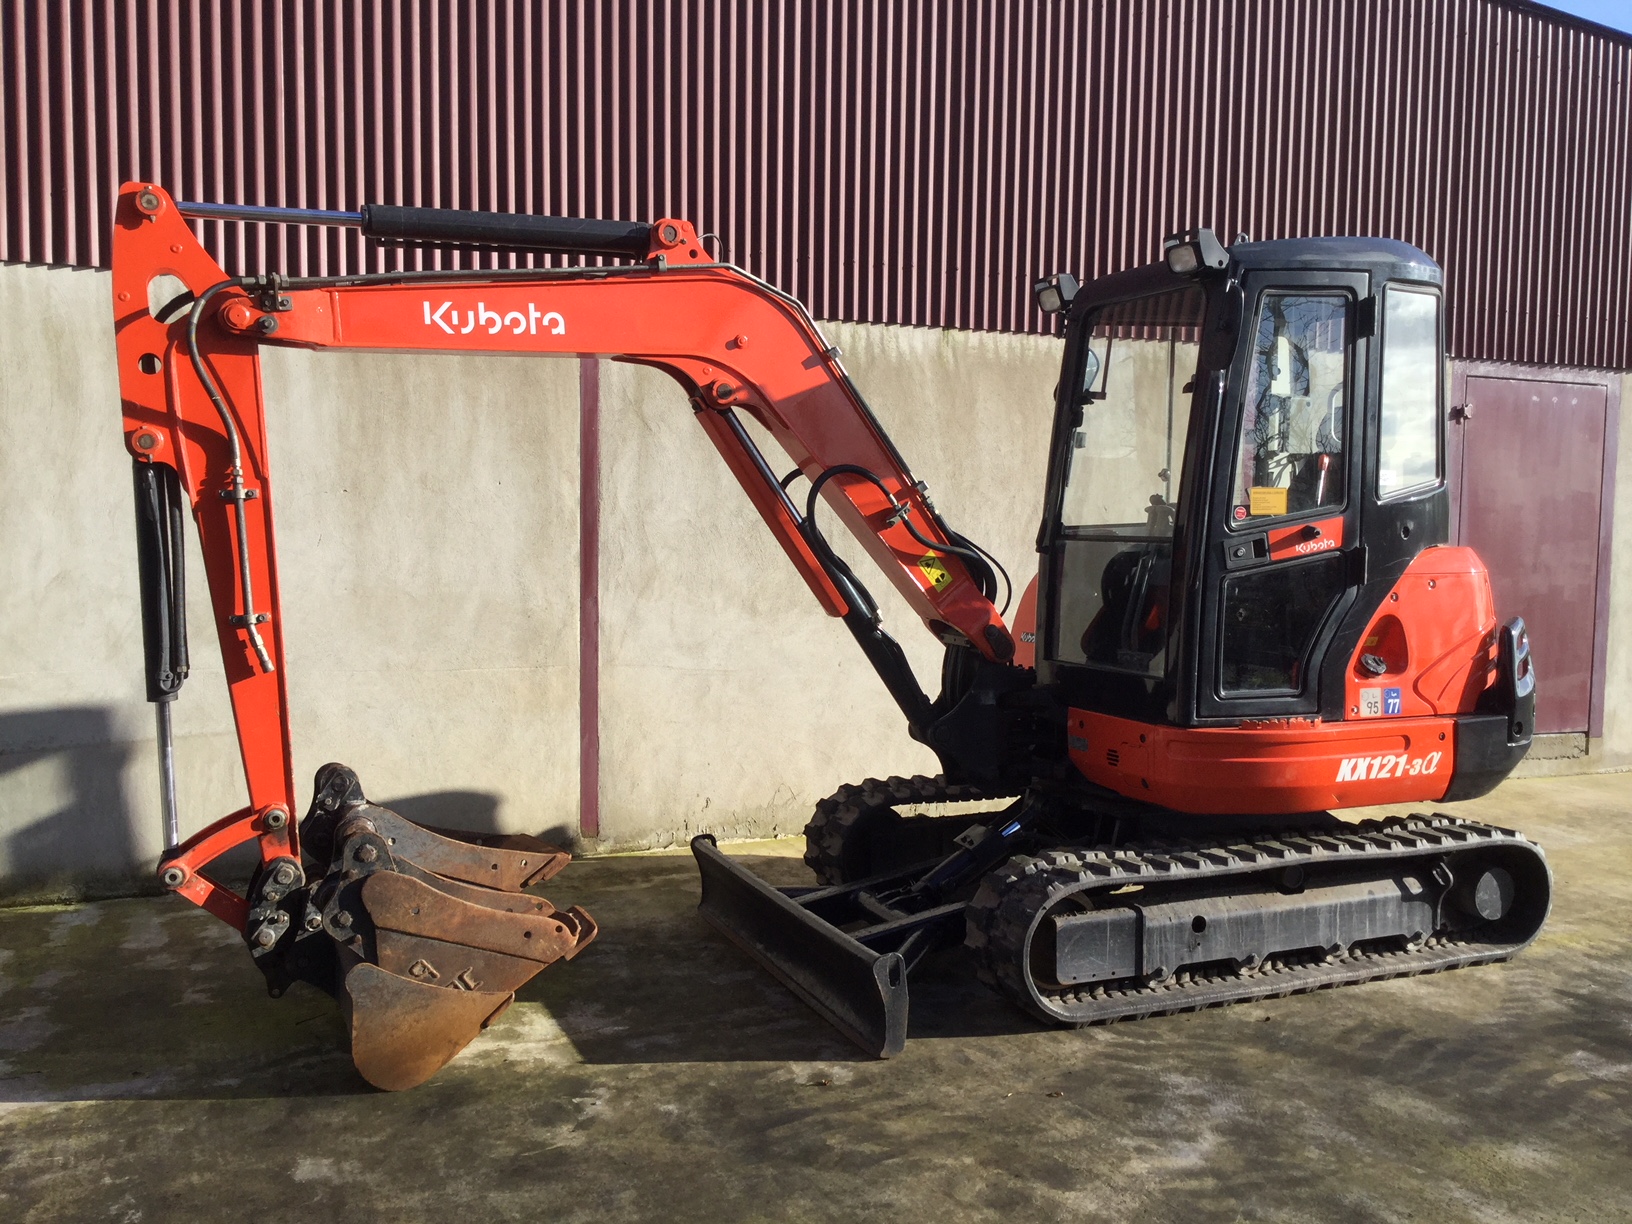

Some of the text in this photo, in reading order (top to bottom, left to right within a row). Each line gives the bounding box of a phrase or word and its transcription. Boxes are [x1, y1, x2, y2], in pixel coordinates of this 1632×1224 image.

[423, 301, 566, 335] Kubota
[1295, 538, 1335, 553] Kubota
[1366, 701, 1379, 715] 95
[1387, 698, 1400, 714] 77
